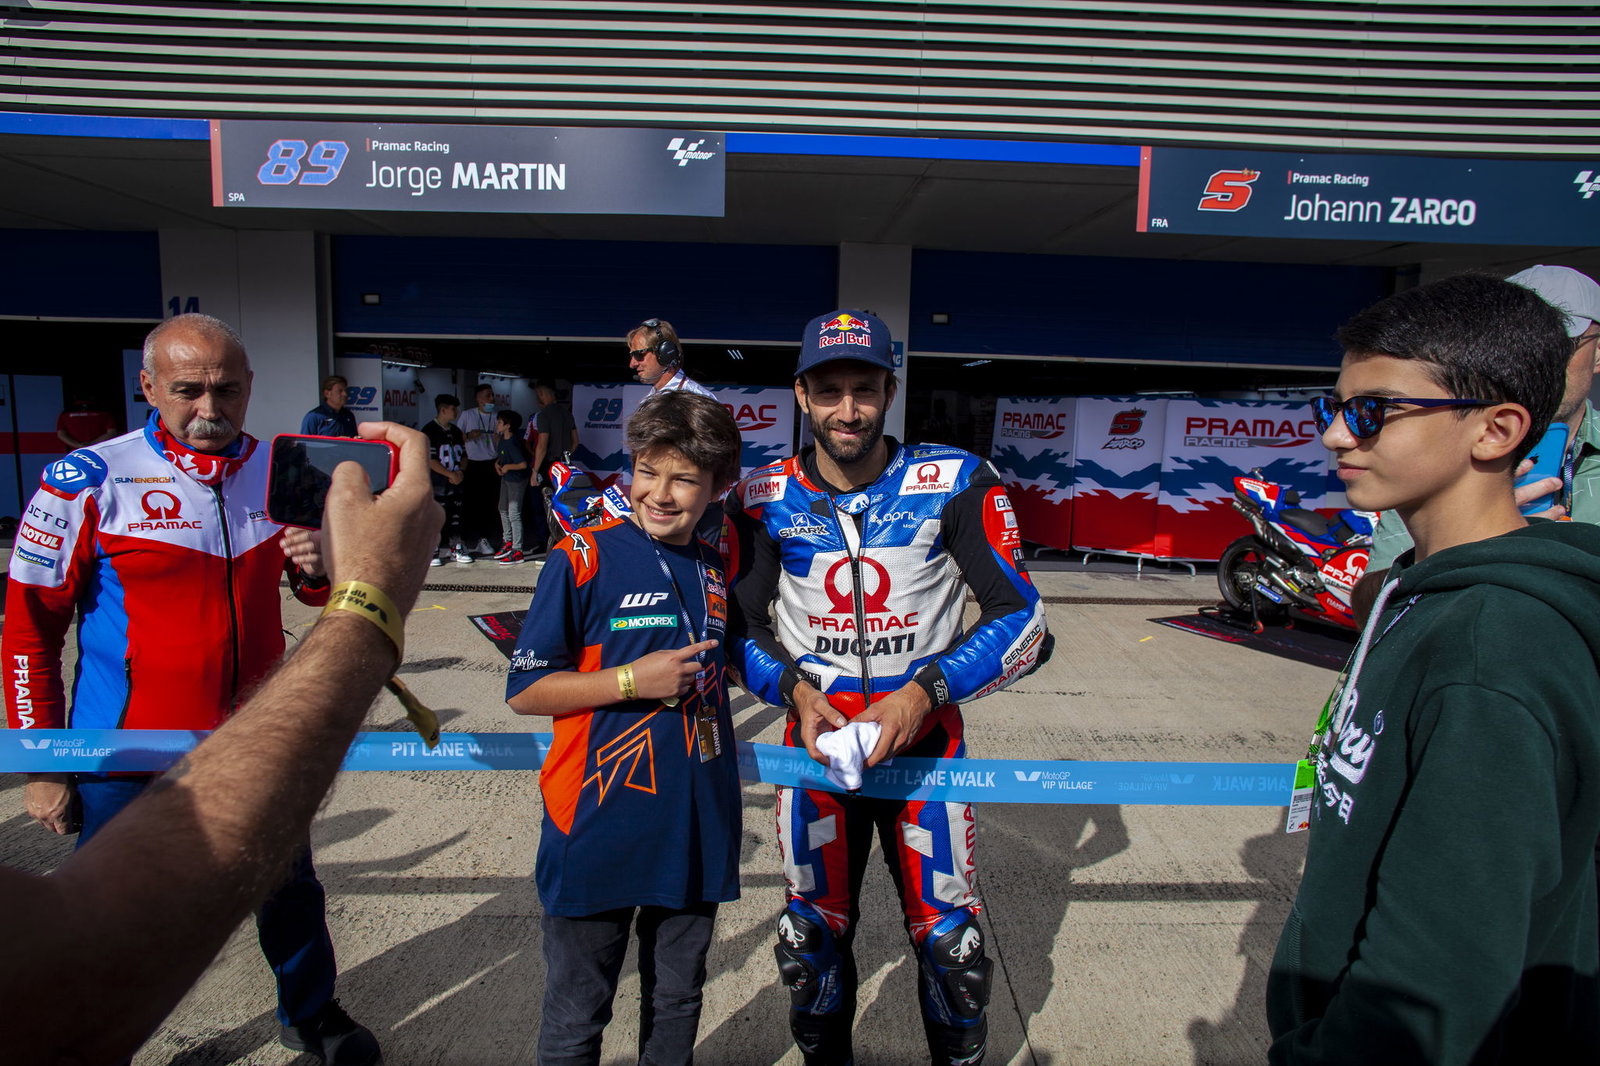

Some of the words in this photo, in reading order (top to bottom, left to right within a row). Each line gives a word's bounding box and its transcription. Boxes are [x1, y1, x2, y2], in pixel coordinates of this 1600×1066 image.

[371, 139, 411, 153] Pramac
[414, 141, 450, 155] Racing
[256, 139, 350, 186] 89
[366, 160, 442, 196] Jorge
[452, 162, 566, 191] MARTIN
[1292, 172, 1332, 185] Pramac
[1334, 174, 1370, 187] Racing
[228, 192, 246, 202] SPA
[1284, 194, 1382, 223] Johann
[1388, 197, 1477, 227] ZARCO
[1151, 217, 1169, 229] FRA
[819, 332, 844, 349] Red
[846, 330, 871, 349] Bull
[587, 397, 624, 422] 89
[1001, 411, 1067, 432] PRAMAC
[1185, 416, 1318, 438] PRAMAC
[1001, 427, 1033, 439] RACING
[1184, 436, 1250, 448] RACING
[749, 480, 780, 496] FIAMM
[906, 481, 950, 492] PRAMAC
[127, 520, 203, 533] PRAMAC
[778, 522, 831, 540] SHARK
[20, 524, 60, 549] MOTUL
[628, 616, 675, 628] MOTOREX
[807, 611, 919, 634] PRAMAC
[814, 632, 916, 658] DUCATI
[1004, 624, 1042, 666] GENERAC
[976, 652, 1036, 699] PRAMAC
[13, 654, 36, 729] PRAMA
[52, 739, 86, 747] MotoGP
[391, 742, 417, 757] PIT
[422, 742, 464, 757] LANE
[467, 742, 514, 757] WALK
[53, 748, 70, 757] VIP
[71, 748, 112, 757] VILLAGE
[875, 770, 901, 784] PIT
[905, 771, 946, 787] LANE
[952, 771, 996, 788] WALK
[1041, 770, 1071, 779] MotoGP
[1042, 780, 1057, 790] VIP
[1059, 780, 1094, 790] VILLAGE
